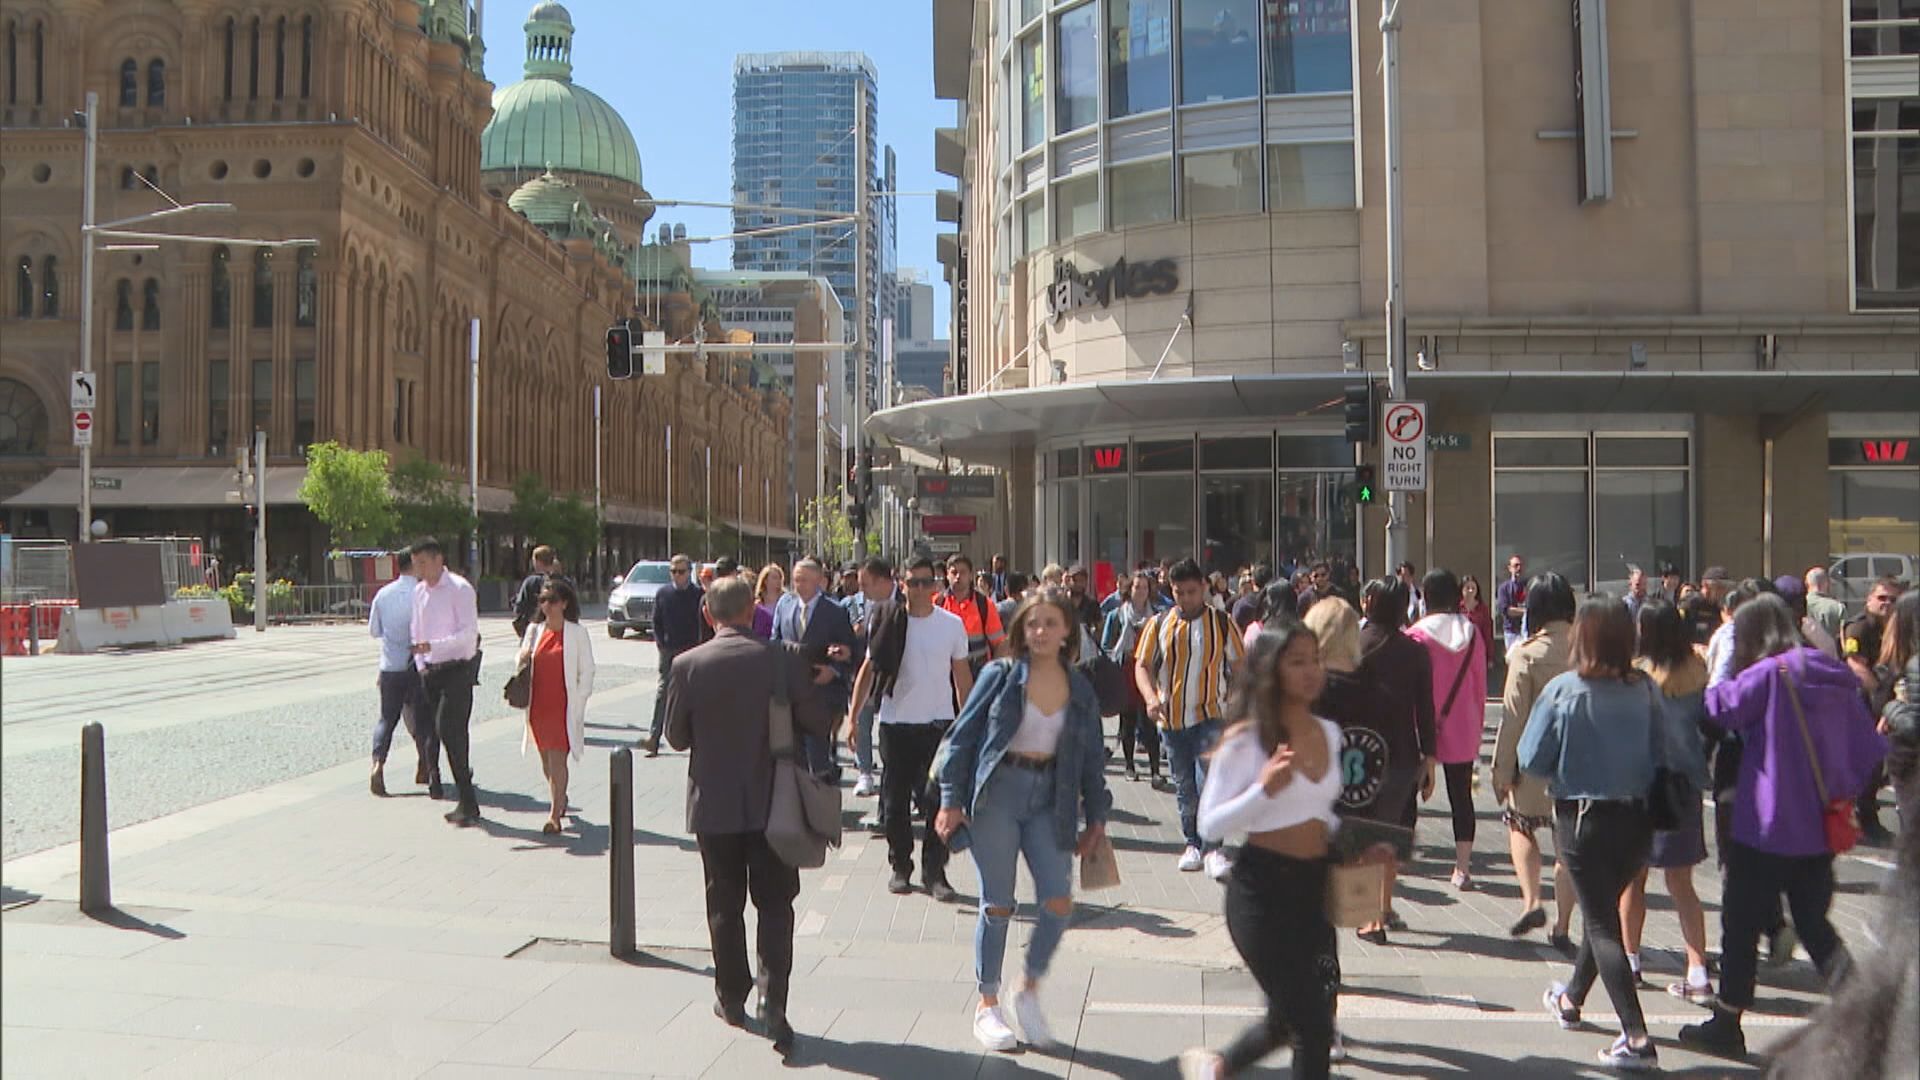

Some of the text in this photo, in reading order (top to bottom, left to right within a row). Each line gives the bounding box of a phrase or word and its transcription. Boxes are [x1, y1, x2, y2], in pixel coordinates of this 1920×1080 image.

[1427, 434, 1459, 446] Park St
[1393, 446, 1416, 460] NO
[1388, 462, 1421, 472] RIGHT
[1390, 475, 1420, 486] TURN
